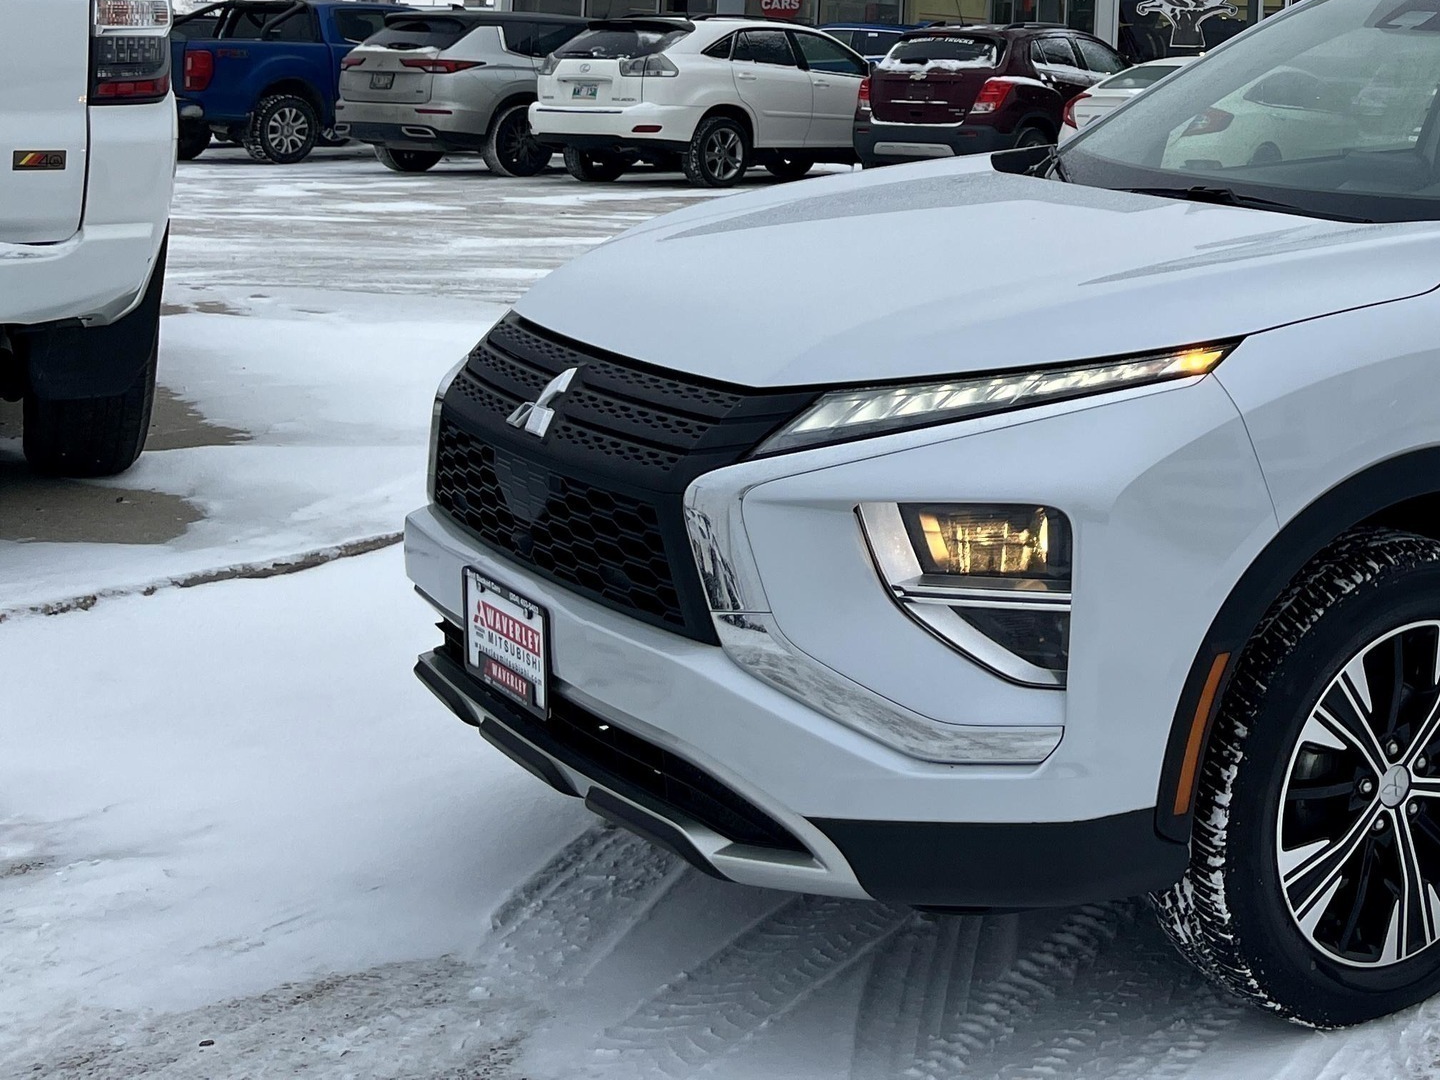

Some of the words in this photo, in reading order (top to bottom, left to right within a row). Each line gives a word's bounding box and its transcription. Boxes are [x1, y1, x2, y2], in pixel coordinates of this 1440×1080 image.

[486, 606, 540, 653] WAVERLEY
[488, 631, 541, 672] MITSUBISHI
[492, 662, 527, 695] WAVERLEY
